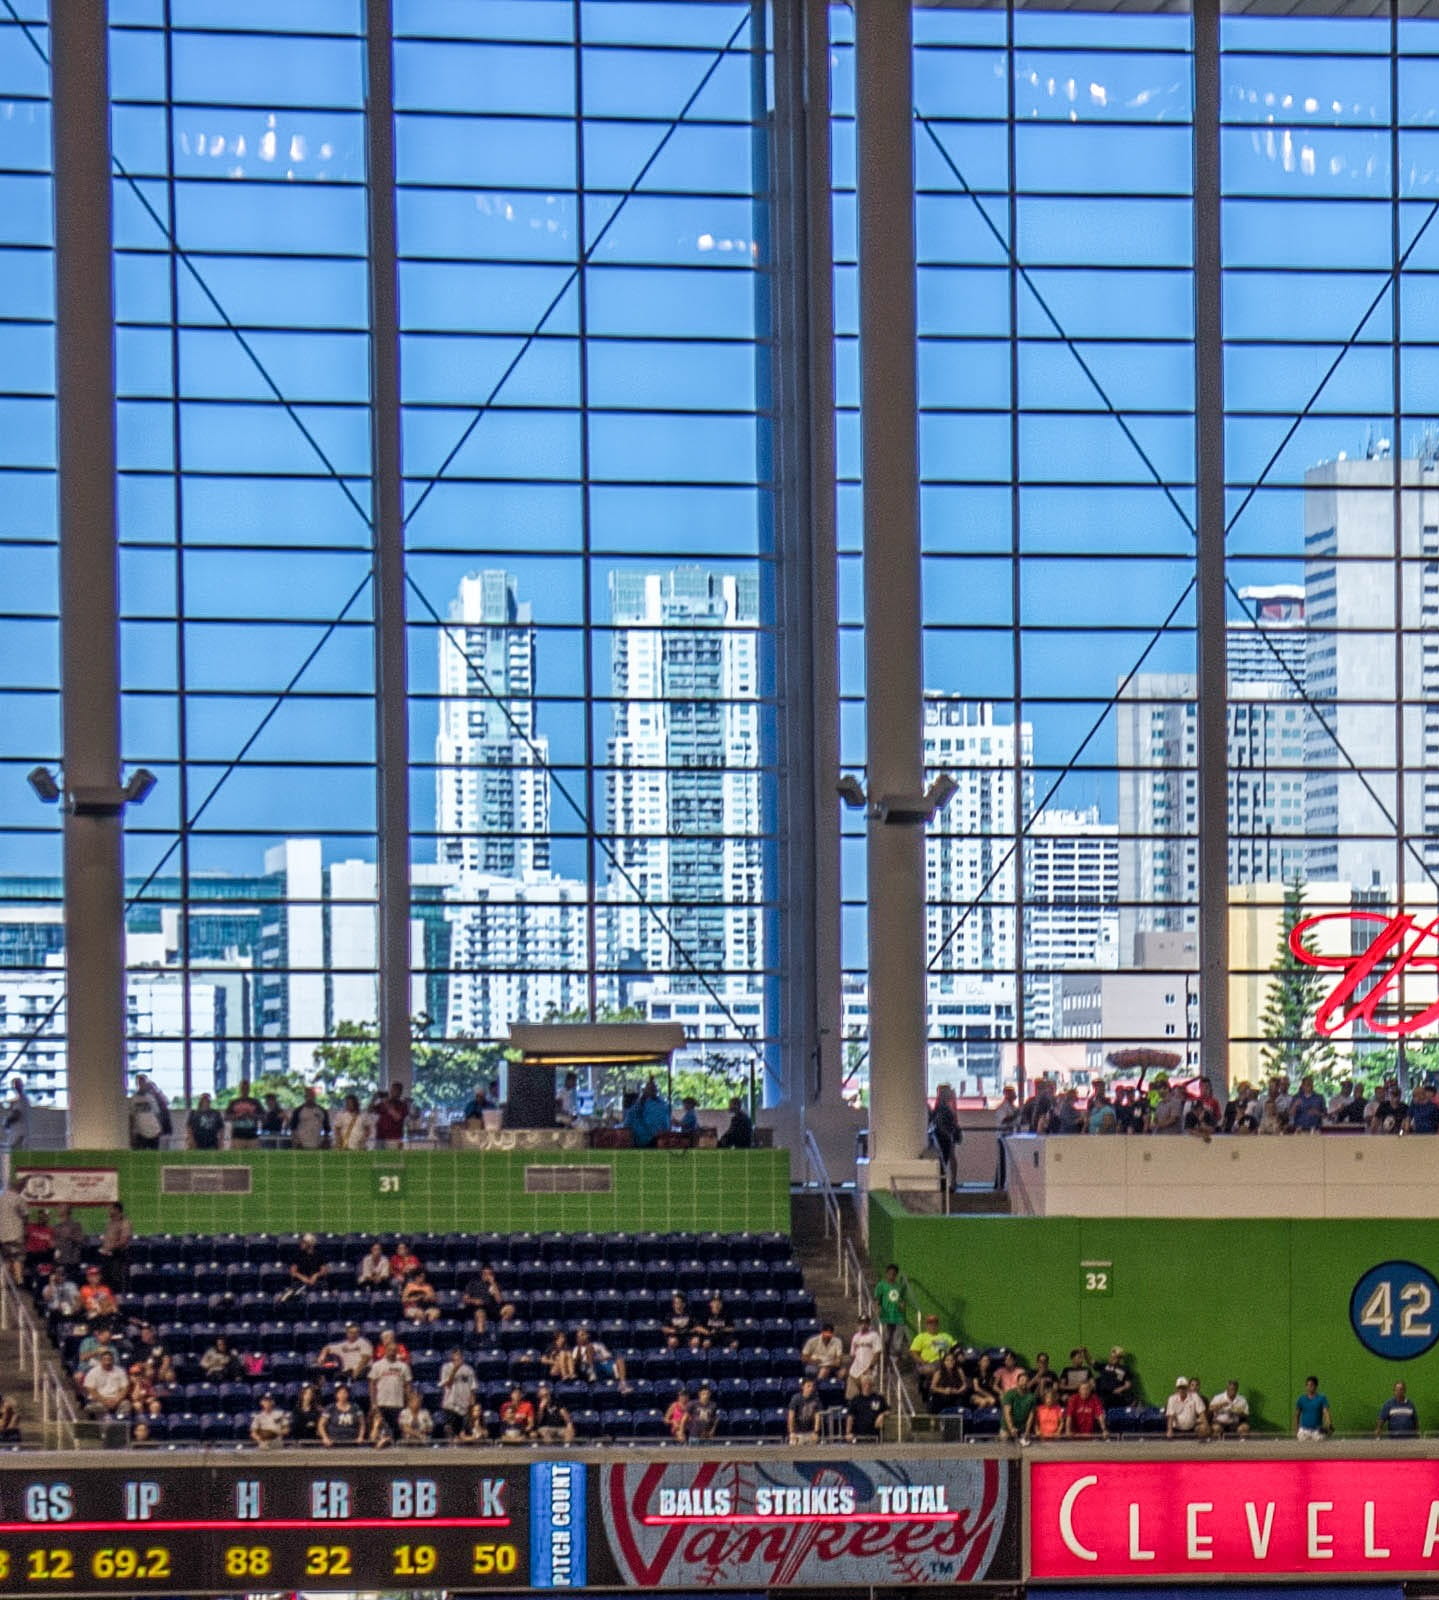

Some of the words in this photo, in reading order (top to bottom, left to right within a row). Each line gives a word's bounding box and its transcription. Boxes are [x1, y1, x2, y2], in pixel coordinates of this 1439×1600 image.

[380, 1176, 399, 1191] 31
[1086, 1273, 1107, 1290] 32
[1361, 1281, 1432, 1337] 42
[26, 1483, 72, 1521] GS
[125, 1481, 160, 1520] IP
[236, 1481, 260, 1519] H
[312, 1481, 349, 1518] ER
[391, 1480, 437, 1518] BB
[481, 1478, 505, 1517] K
[552, 1464, 571, 1526] COUNT
[659, 1488, 730, 1516] BALLS
[755, 1486, 854, 1515] STRIKES
[877, 1485, 948, 1513] TOTAL
[27, 1550, 74, 1579] 12
[92, 1548, 171, 1579] 69.2
[226, 1547, 272, 1576] 88
[305, 1545, 352, 1575] 32
[392, 1545, 437, 1575] 19
[472, 1544, 518, 1574] 50
[552, 1531, 571, 1586] PITCH
